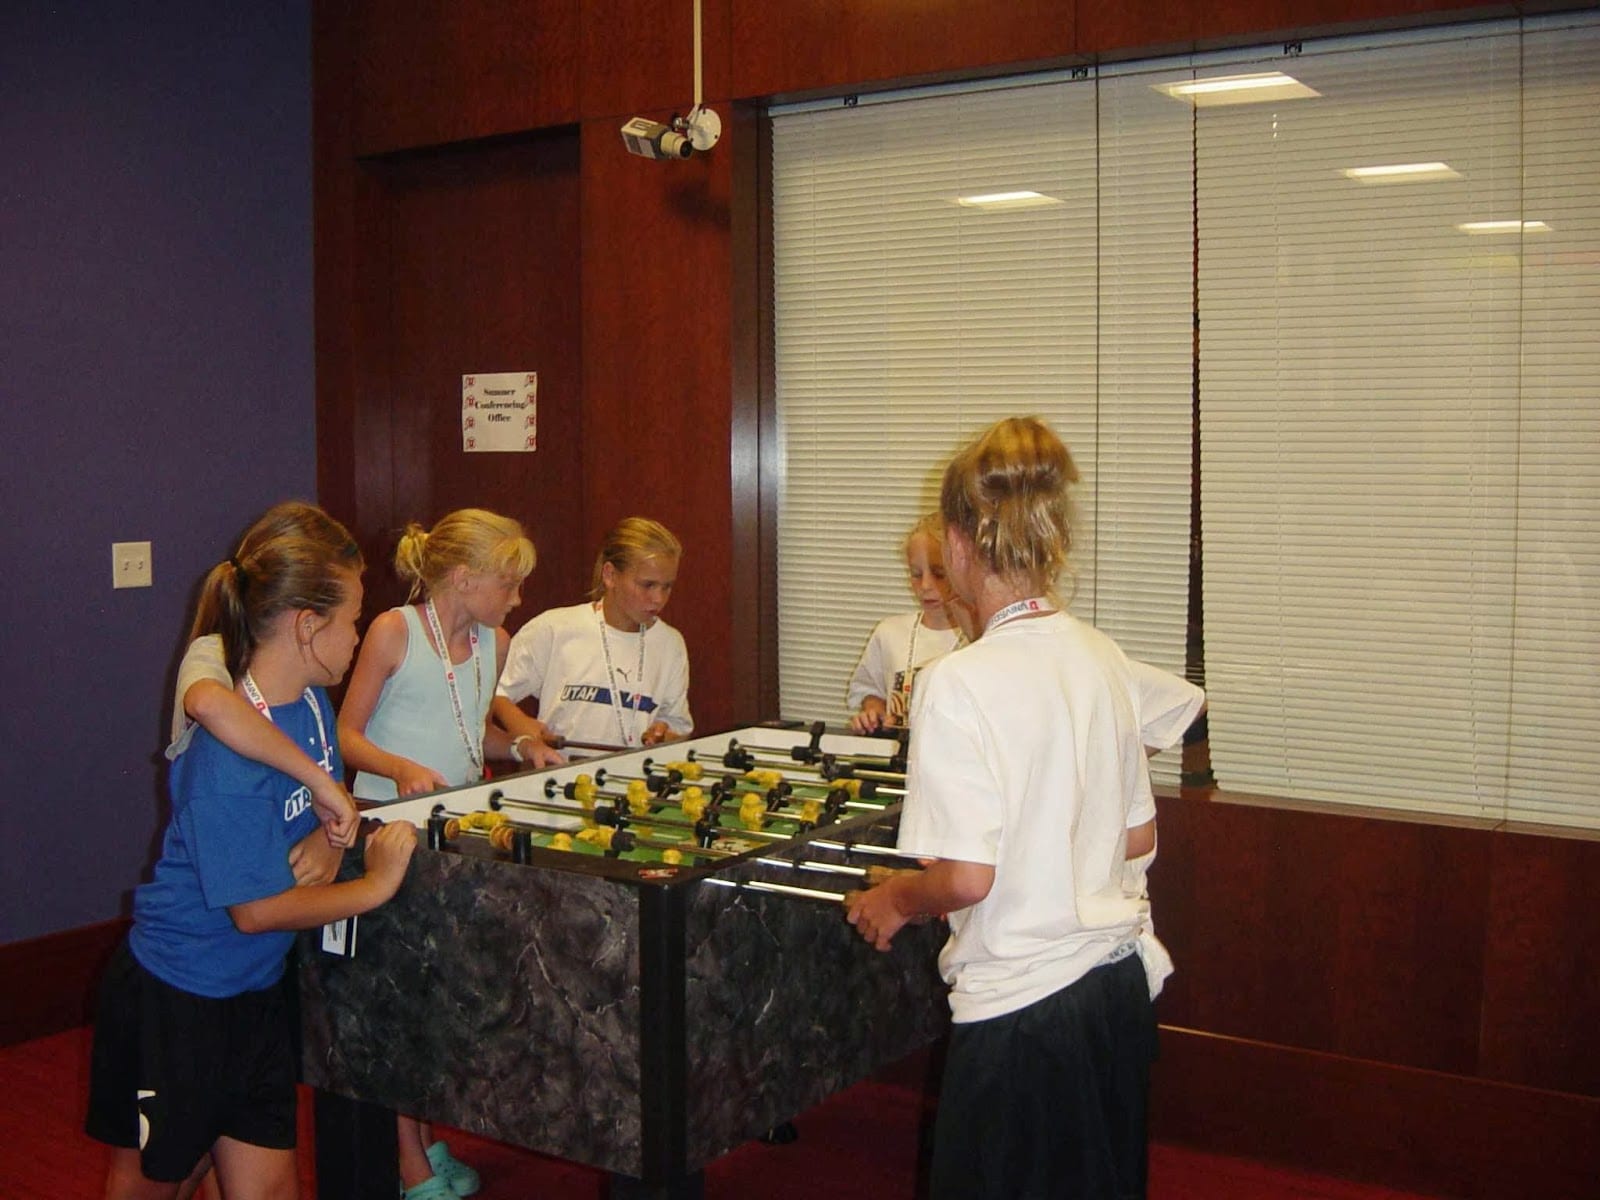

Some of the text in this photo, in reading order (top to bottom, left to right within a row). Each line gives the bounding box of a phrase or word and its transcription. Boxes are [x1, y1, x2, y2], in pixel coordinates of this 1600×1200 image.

[483, 388, 516, 397] Summer
[475, 400, 526, 410] Conferencing
[488, 413, 512, 422] Office
[560, 685, 600, 702] UTAH
[284, 786, 312, 822] UTA
